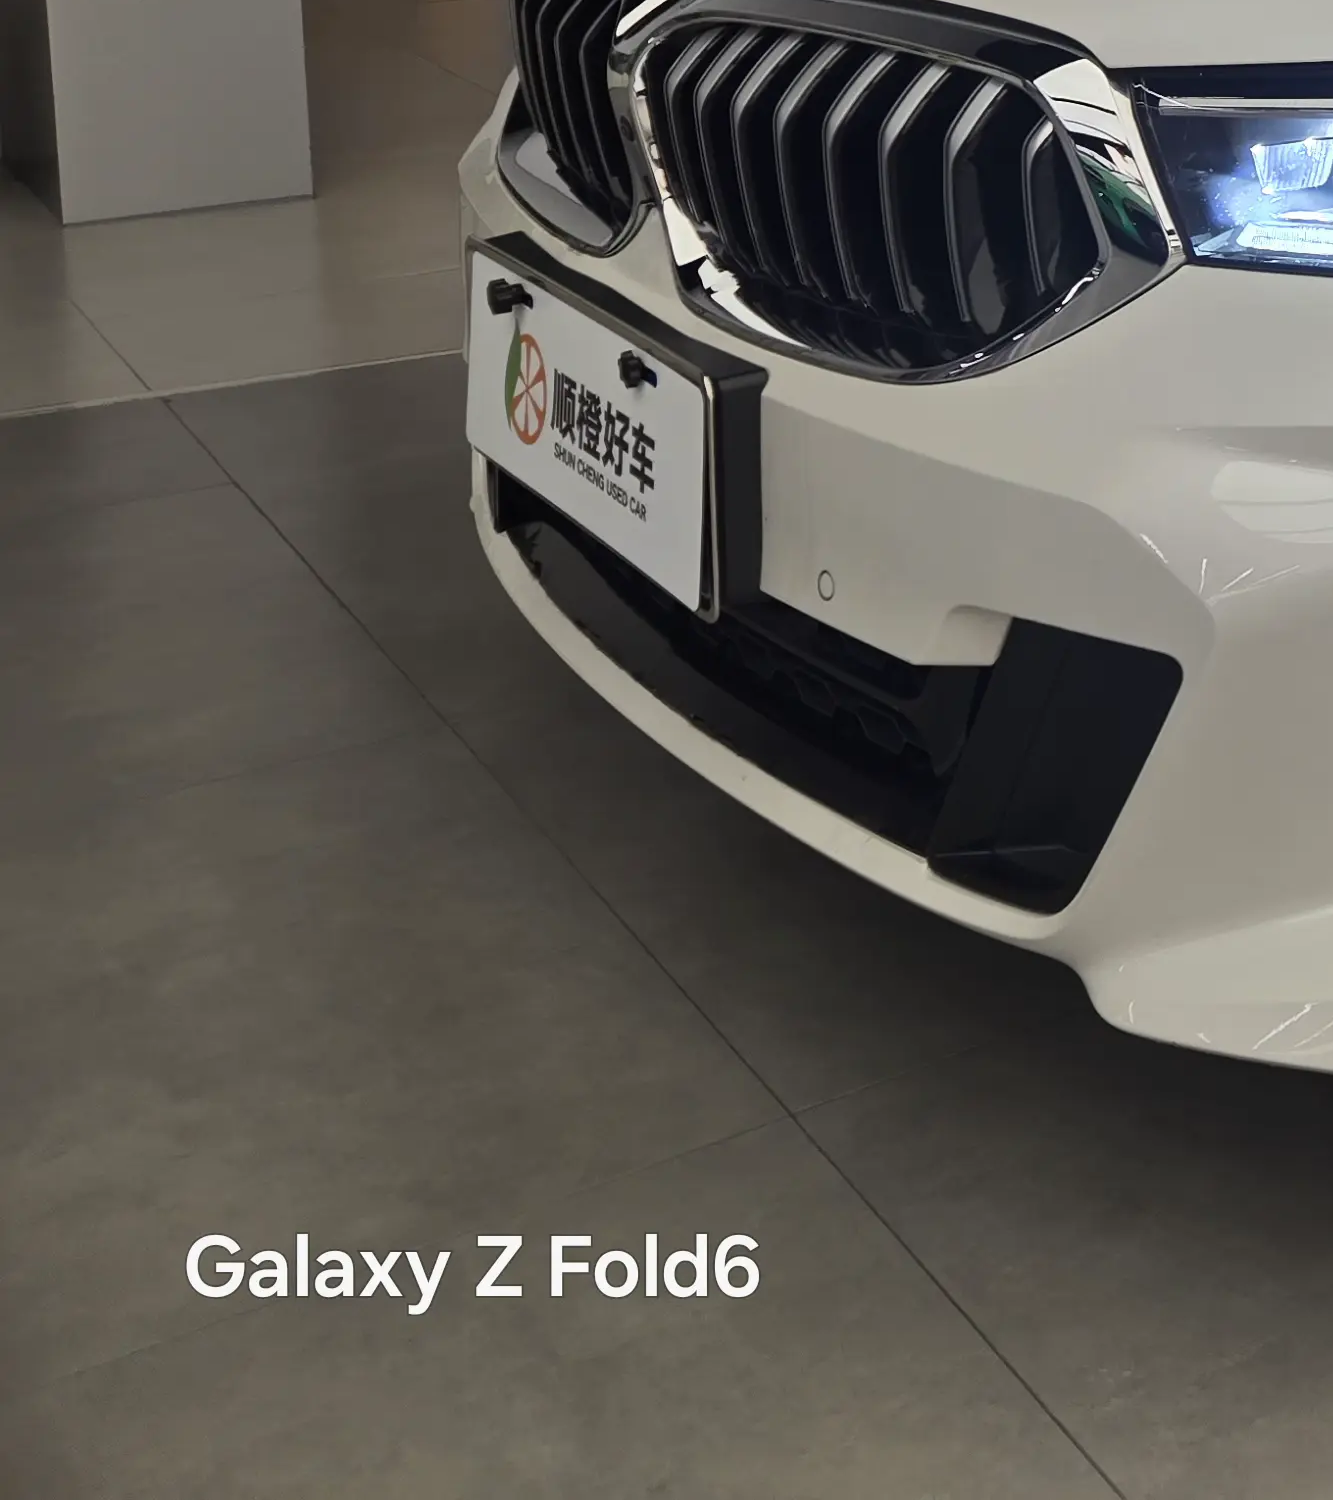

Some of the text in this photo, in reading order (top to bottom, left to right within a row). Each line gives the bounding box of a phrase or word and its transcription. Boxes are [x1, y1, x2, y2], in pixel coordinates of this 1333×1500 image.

[550, 368, 655, 494] 顺橙好车
[554, 442, 647, 522] SHUN CHENG USED CAR
